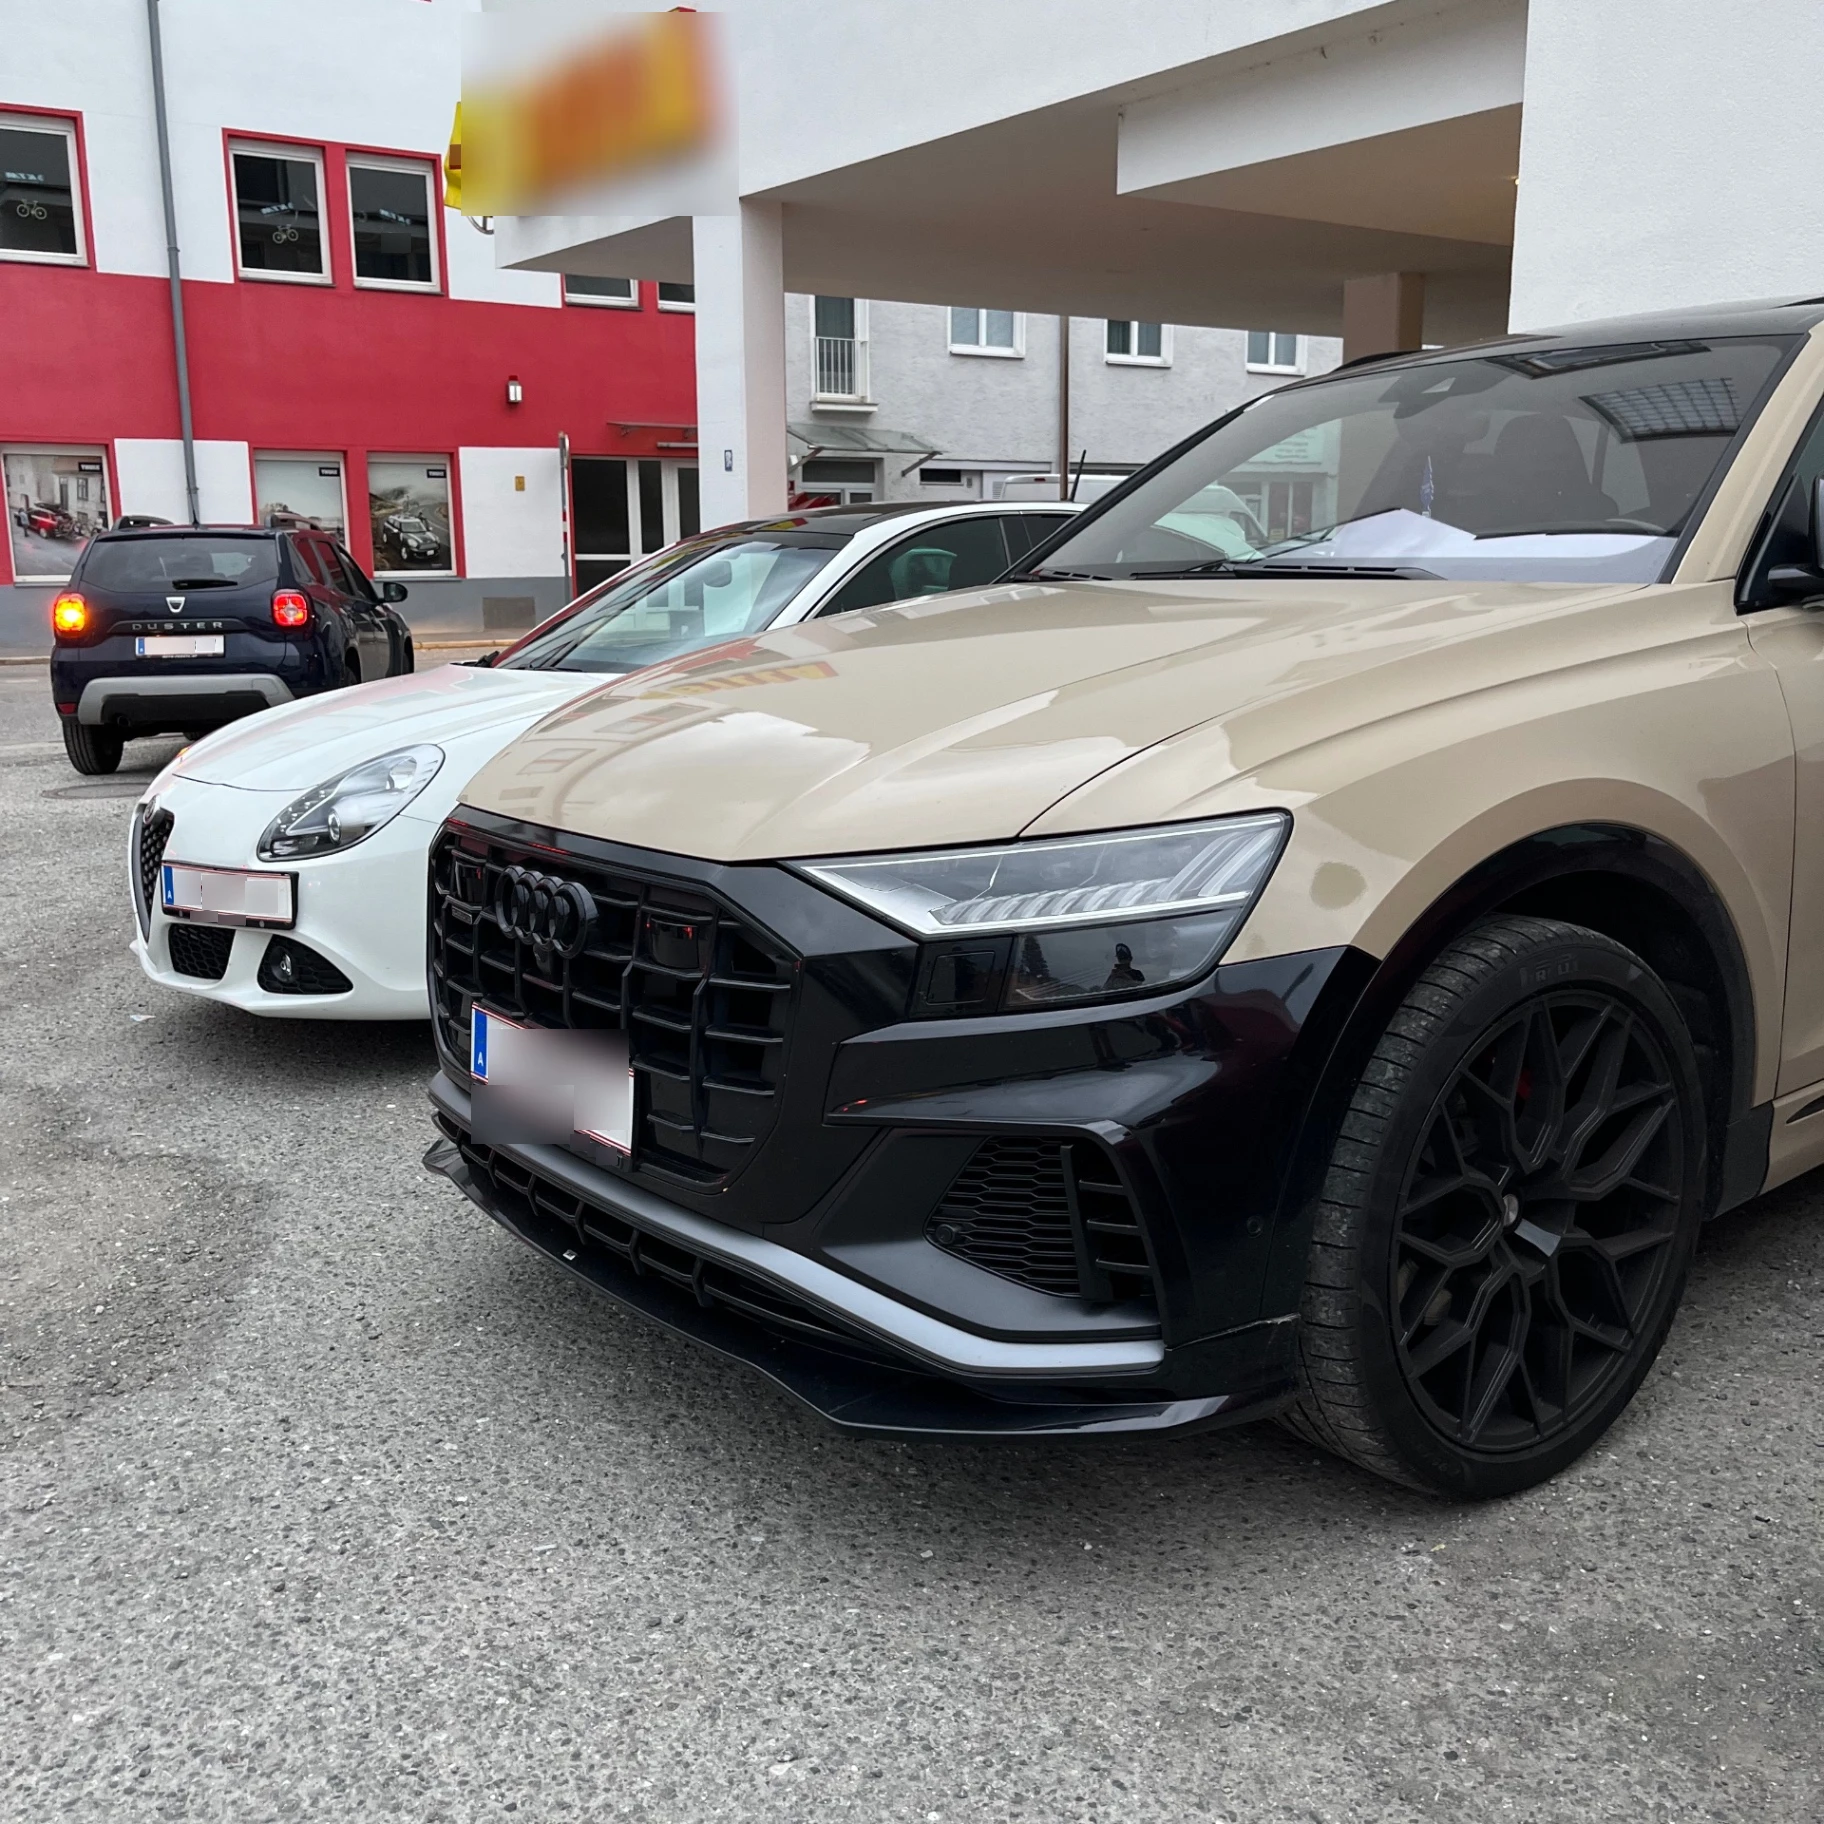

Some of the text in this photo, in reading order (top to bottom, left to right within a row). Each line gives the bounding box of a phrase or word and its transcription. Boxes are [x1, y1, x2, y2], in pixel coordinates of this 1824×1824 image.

[132, 622, 223, 630] DUSTER
[167, 889, 173, 900] A
[477, 1051, 484, 1067] A
